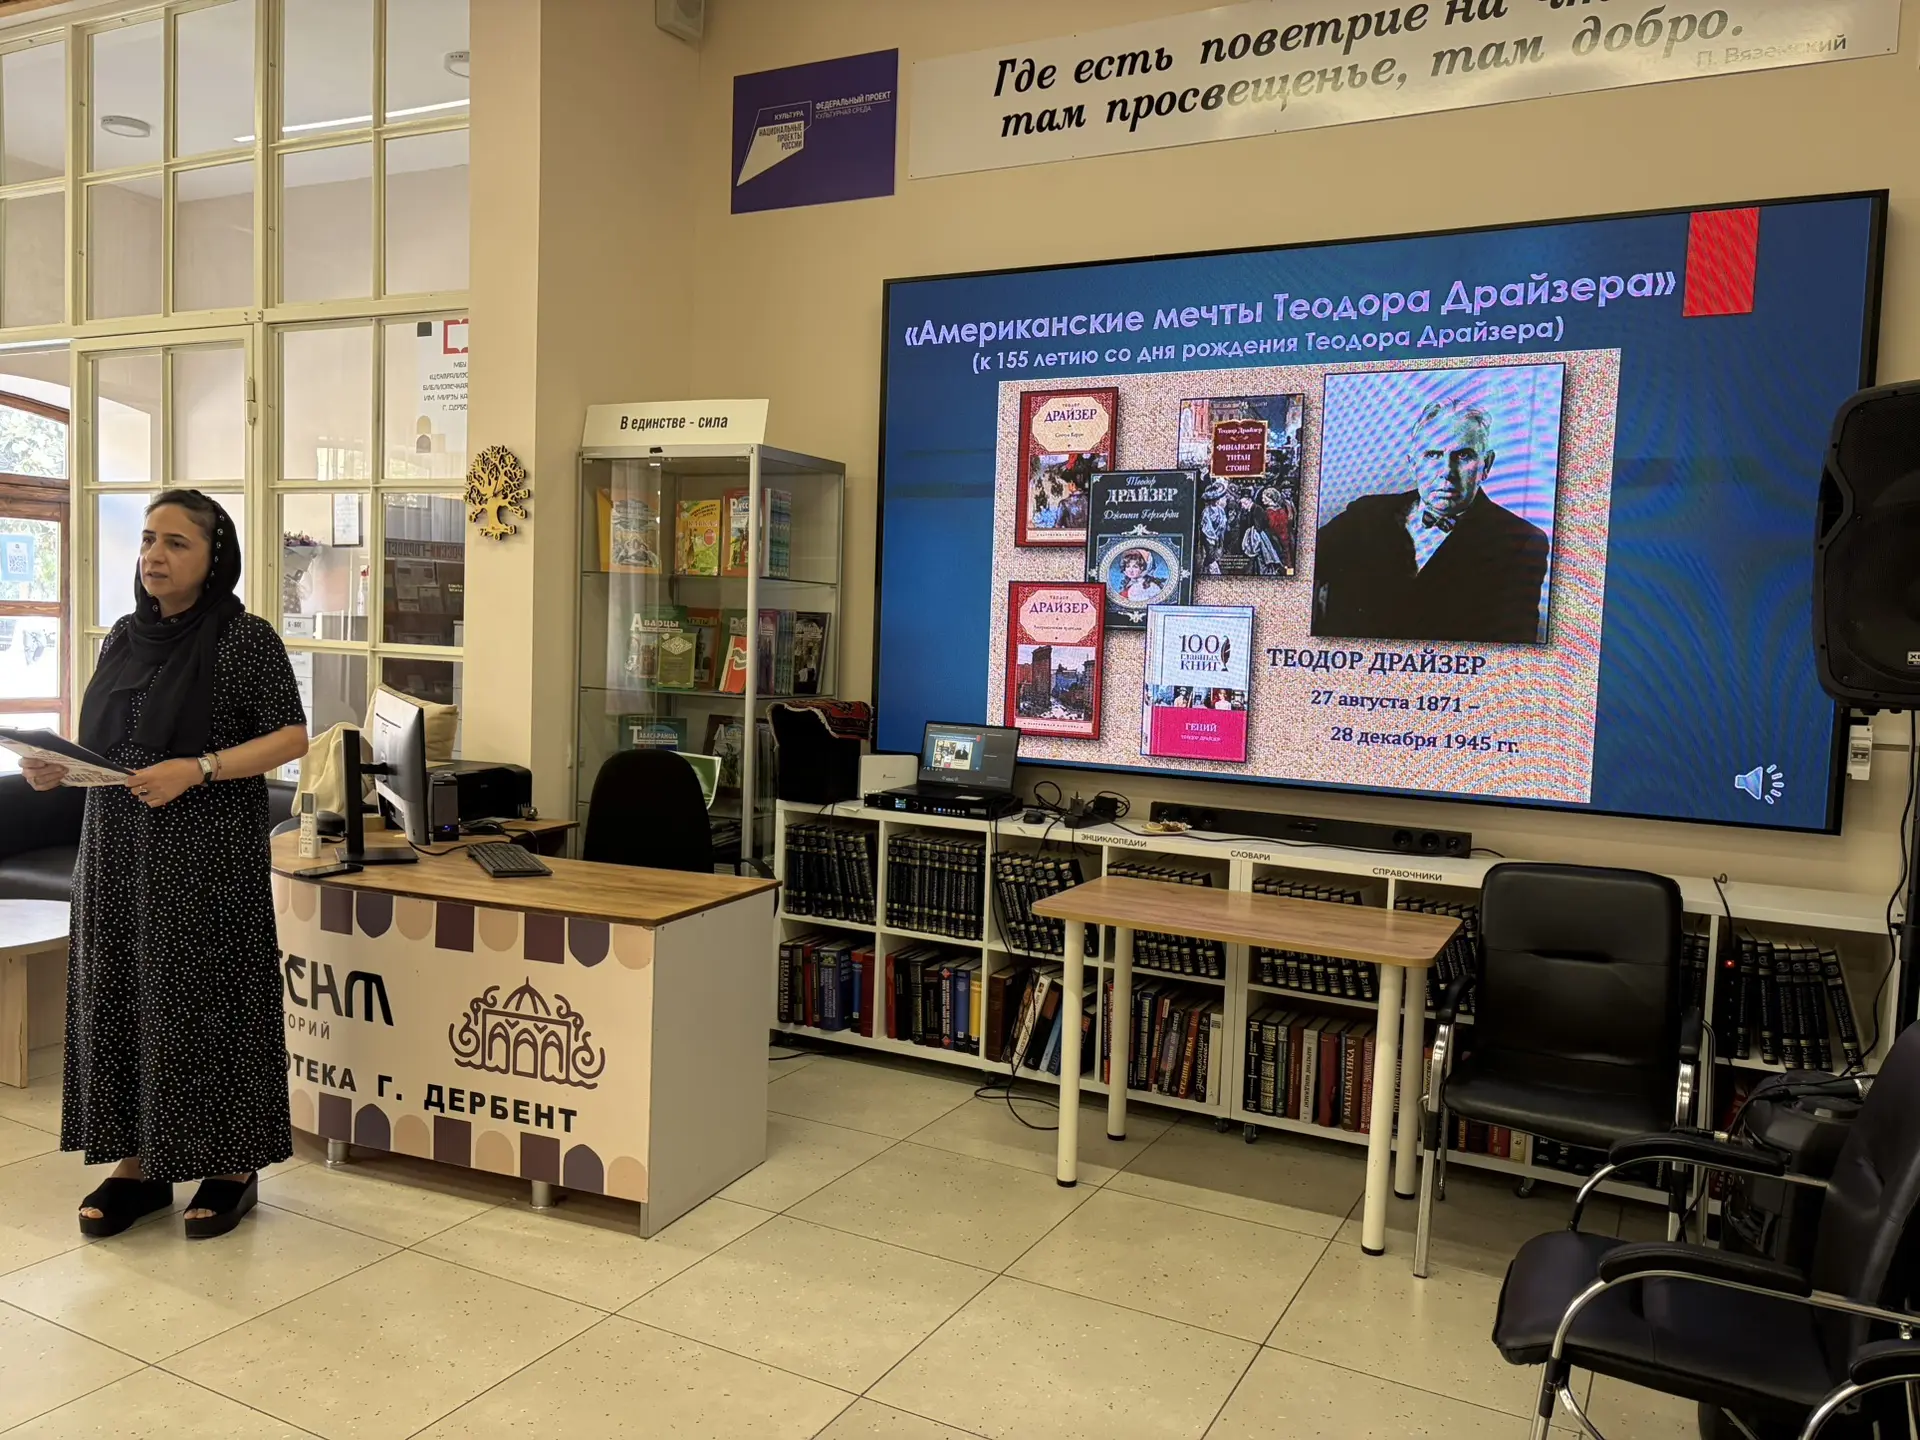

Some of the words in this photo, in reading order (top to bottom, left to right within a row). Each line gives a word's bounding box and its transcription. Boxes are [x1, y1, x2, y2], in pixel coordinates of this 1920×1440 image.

[994, 59, 1056, 98] Где
[1073, 43, 1174, 82] есть
[1200, 4, 1428, 65] поветрие
[1444, 0, 1509, 26] на
[1000, 103, 1087, 138] там
[1105, 57, 1407, 132] просвещенье,
[1430, 35, 1545, 77] там
[1572, 4, 1743, 58] добро.
[815, 94, 864, 110] ФЕДЕРАЛЬНЫЙ
[865, 91, 891, 102] ПРОЕКТ
[774, 110, 805, 121] КУЛЬТУРА
[852, 106, 872, 115] СРЕДА
[758, 122, 802, 137] НАЦИОНАЛЬНЫЕ
[777, 132, 802, 144] ПРОЕКТЫ
[781, 141, 802, 151] РОССИИ
[905, 309, 1145, 348] «Американские
[1153, 299, 1264, 331] мечты
[1273, 287, 1431, 322] Теодора
[1441, 271, 1677, 316] Драйзера»
[972, 351, 991, 374] (к
[997, 350, 1029, 369] 155
[1033, 350, 1099, 368] летию
[1104, 347, 1132, 363] со
[1137, 345, 1175, 364] дня
[1182, 336, 1298, 363] рождения
[1306, 328, 1411, 352] Теодора
[1417, 316, 1566, 349] Драйзера)
[620, 415, 628, 431] В
[631, 415, 686, 432] единстве
[697, 414, 729, 430] сила
[1044, 407, 1098, 423] ДРАЙЗЕР
[1105, 486, 1179, 506] ДРАЙЗЕР
[1029, 601, 1089, 614] ДРАЙЗЕР
[1179, 633, 1220, 654] 100
[1180, 660, 1221, 672] КНИГ
[1267, 648, 1364, 672] ТЕОДОР
[1368, 650, 1487, 676] ДРАЙЗЕР
[1311, 690, 1333, 706] 27
[1338, 693, 1410, 713] августа
[1416, 696, 1461, 713] 1871
[1185, 722, 1217, 732] ГЕНИЙ
[1330, 726, 1353, 742] 28
[1357, 731, 1438, 750] декабря
[1443, 734, 1492, 751] 1945
[1497, 740, 1520, 753] гг.
[1081, 833, 1148, 849] ЭНЦИКЛОПЕДИИ
[1230, 848, 1271, 862] СЛОВАРИ
[1372, 866, 1443, 882] СПРАВОЧНИКИ
[283, 1011, 330, 1040] ОРИЙ
[1179, 1060, 1190, 1095] СРЕДНИЕ
[1185, 1036, 1194, 1057] ВЕКА
[1343, 1048, 1355, 1117] МАТЕМАТИКА
[378, 1074, 402, 1101] Г.
[424, 1083, 578, 1134] ДЕРБЕНТ
